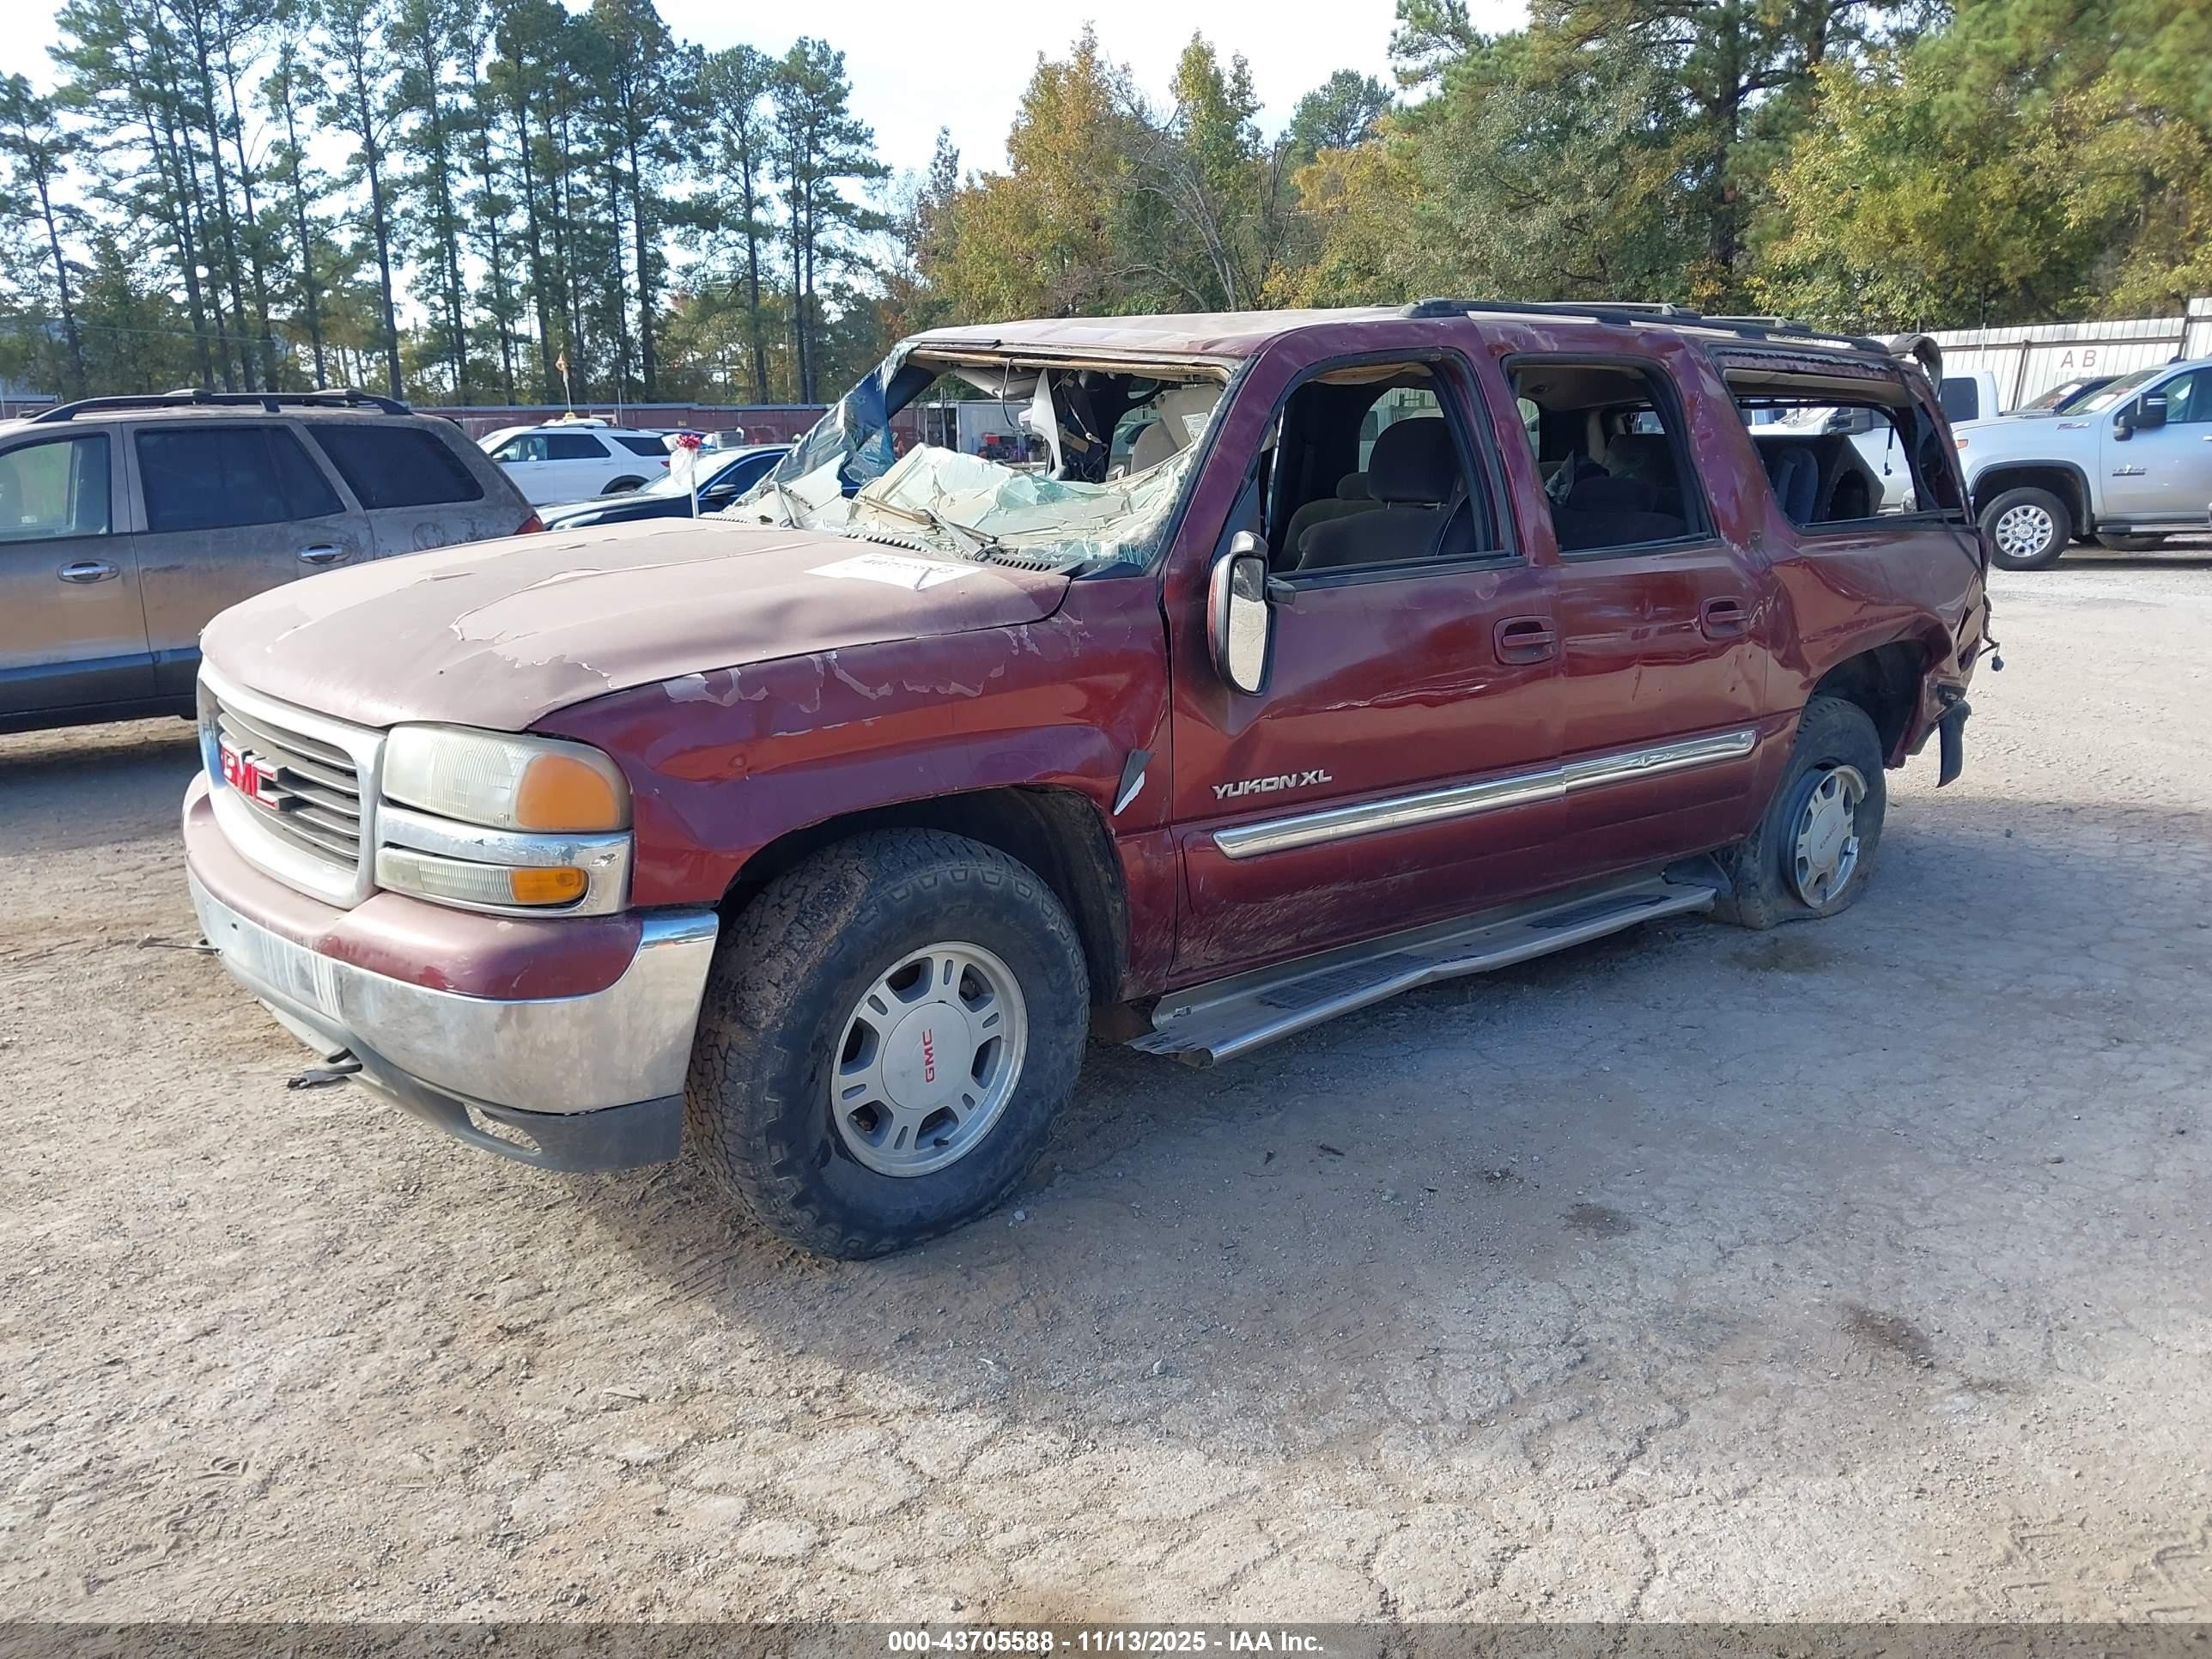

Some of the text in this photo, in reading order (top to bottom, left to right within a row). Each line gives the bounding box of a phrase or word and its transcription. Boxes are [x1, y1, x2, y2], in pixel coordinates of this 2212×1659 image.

[2060, 349, 2097, 368] A B
[220, 738, 281, 812] GMC
[1212, 769, 1333, 799] YUKON XL
[921, 1028, 935, 1084] GMC
